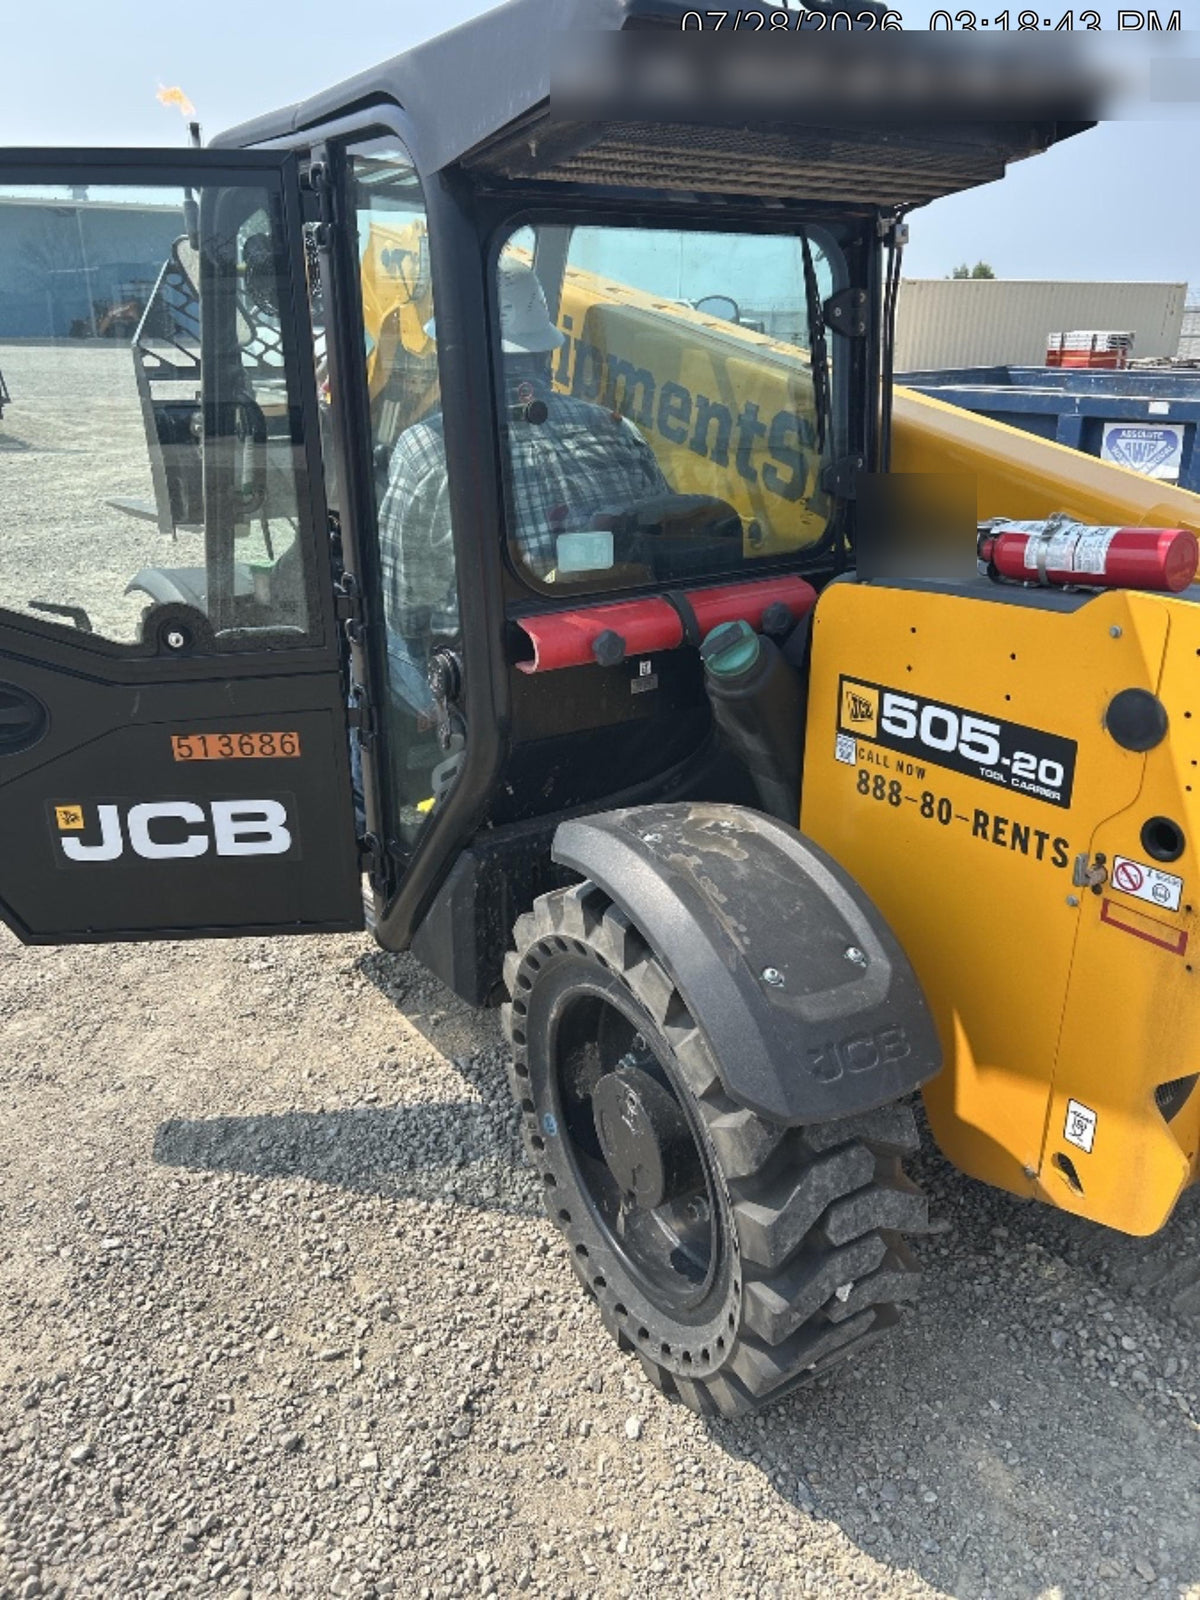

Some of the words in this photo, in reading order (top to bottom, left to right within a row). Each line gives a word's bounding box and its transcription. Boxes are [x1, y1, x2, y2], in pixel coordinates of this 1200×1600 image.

[176, 733, 296, 758] 513686
[858, 748, 890, 769] CALL
[896, 760, 926, 780] NOW
[979, 766, 1007, 784] TOOL
[61, 799, 292, 862] JCB
[856, 769, 1070, 869] 888-80-RENTS
[803, 1027, 911, 1084] JCB
